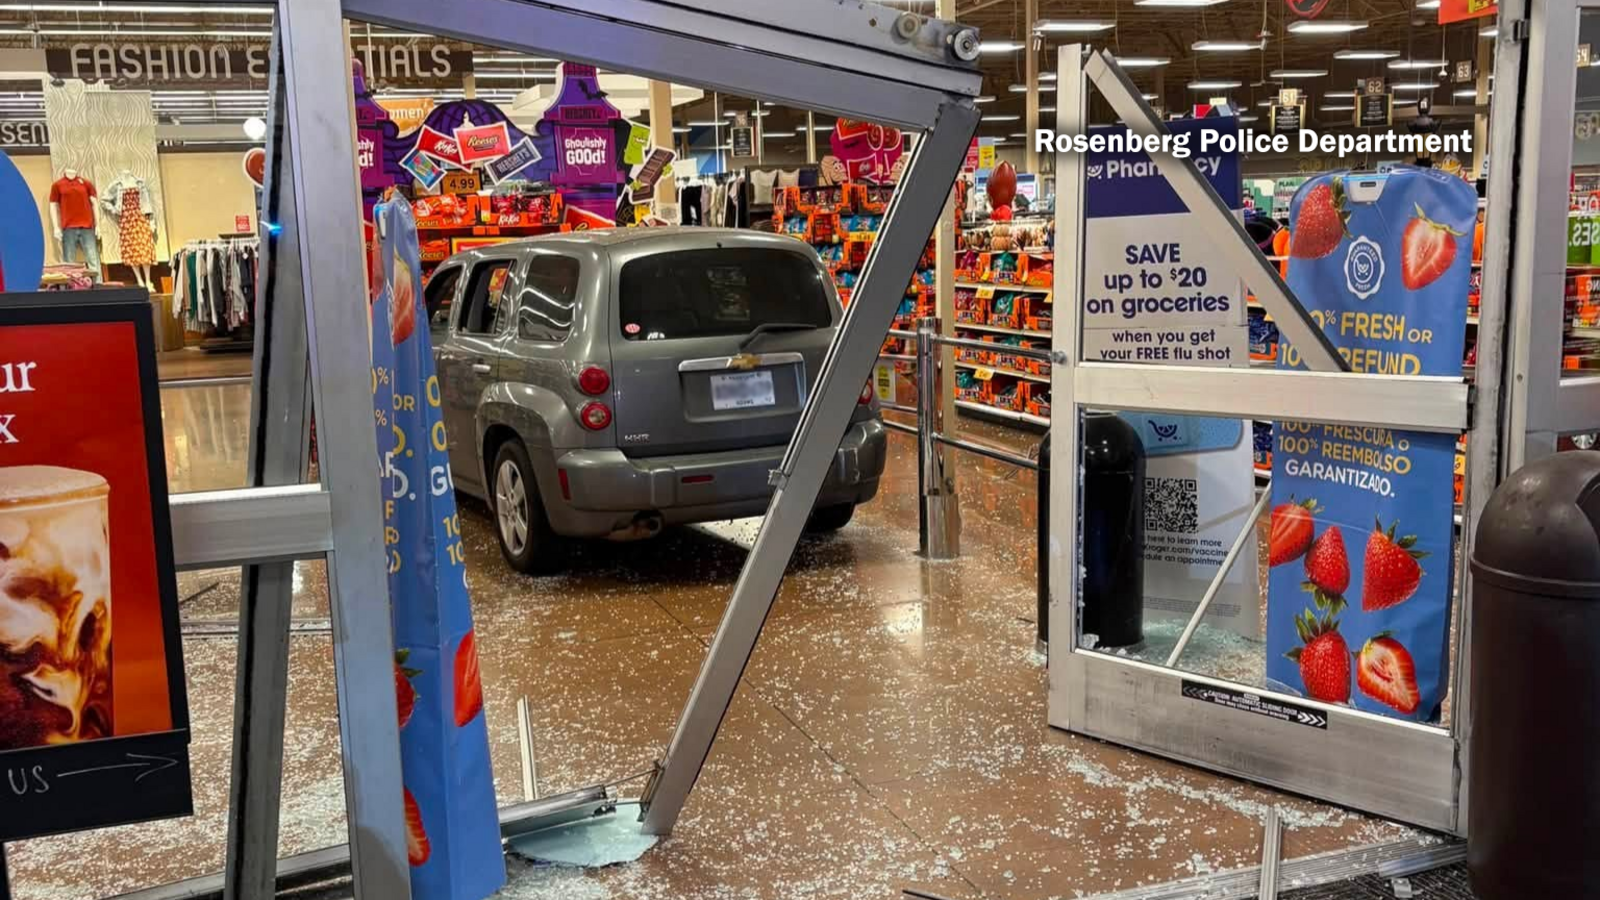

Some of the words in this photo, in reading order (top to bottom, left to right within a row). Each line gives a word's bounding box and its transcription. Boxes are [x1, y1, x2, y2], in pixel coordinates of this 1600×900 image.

[70, 43, 232, 80] FASHION
[1368, 81, 1382, 93] 62
[565, 136, 607, 150] Ghoulishly
[1107, 156, 1221, 178] Pharcy
[450, 178, 475, 189] 4.99
[1126, 243, 1181, 265] SAVE
[1104, 273, 1133, 293] up
[1140, 269, 1163, 289] to
[1170, 267, 1207, 288] $20
[1087, 298, 1114, 313] on
[1122, 292, 1230, 319] groceries
[1112, 330, 1152, 344] when
[1157, 332, 1184, 347] you
[1190, 329, 1216, 345] get
[1341, 312, 1405, 341] FRESH
[1407, 328, 1433, 344] OR
[1100, 350, 1132, 362] your
[1136, 348, 1169, 360] FREE
[1174, 347, 1193, 360] flu
[1197, 346, 1231, 360] shot
[1324, 425, 1395, 449] FRESCURA
[1278, 435, 1318, 454] 100%
[1322, 441, 1411, 475] REEMBOLSO
[1285, 459, 1395, 498] GARANTIZADO.
[1283, 706, 1298, 716] DOOR
